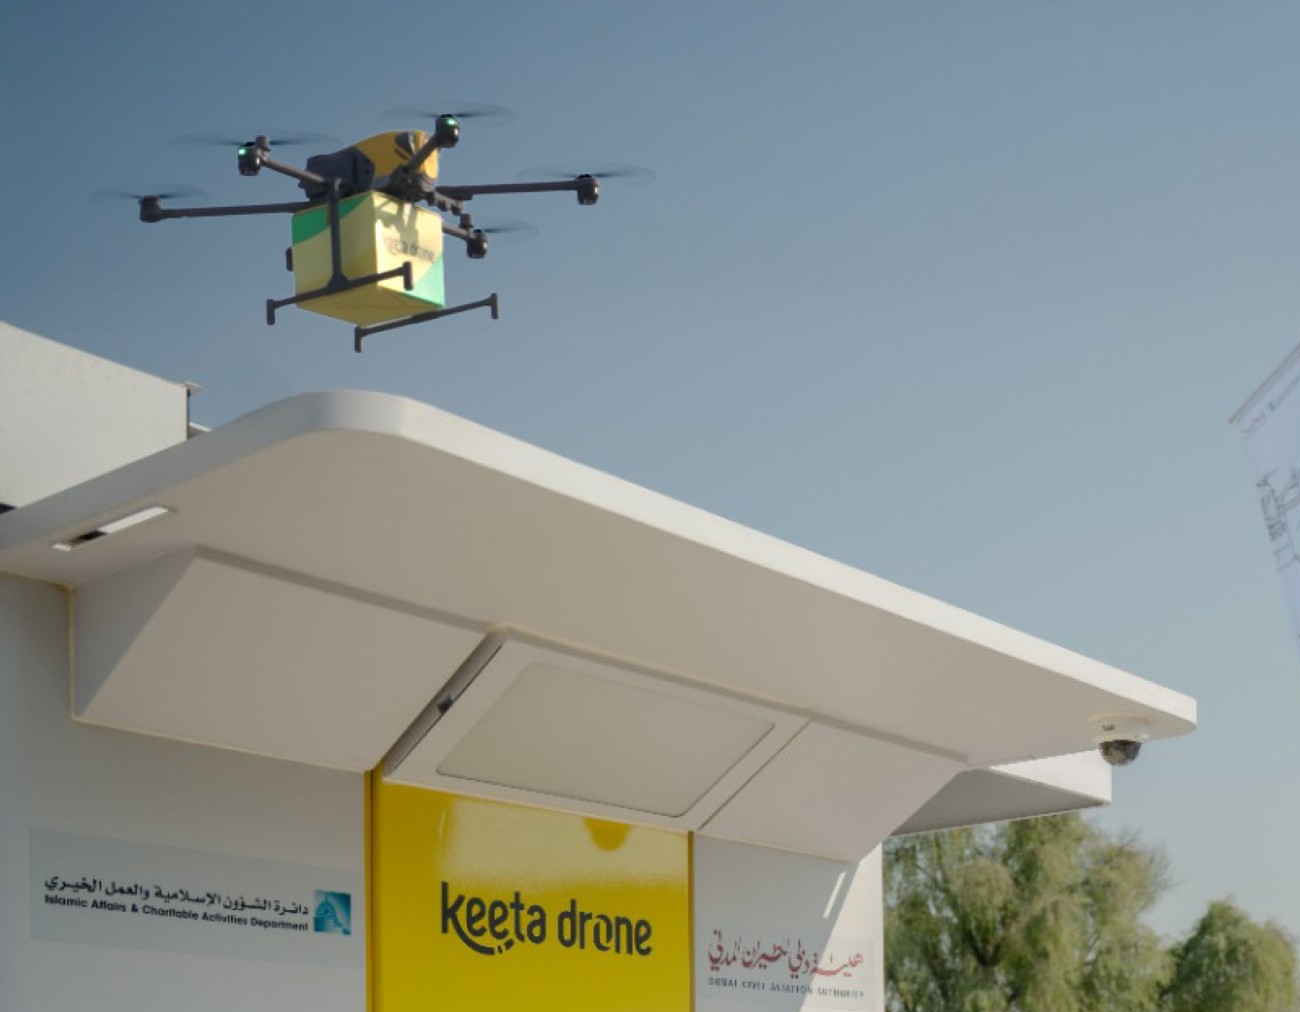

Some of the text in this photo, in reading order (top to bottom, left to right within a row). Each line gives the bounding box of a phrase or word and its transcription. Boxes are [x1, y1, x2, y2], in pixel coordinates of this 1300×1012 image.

[105, 881, 150, 900] والعمل
[44, 894, 309, 932] Islamic Affairs & Charitable Activities Department
[441, 881, 653, 957] keeta drone
